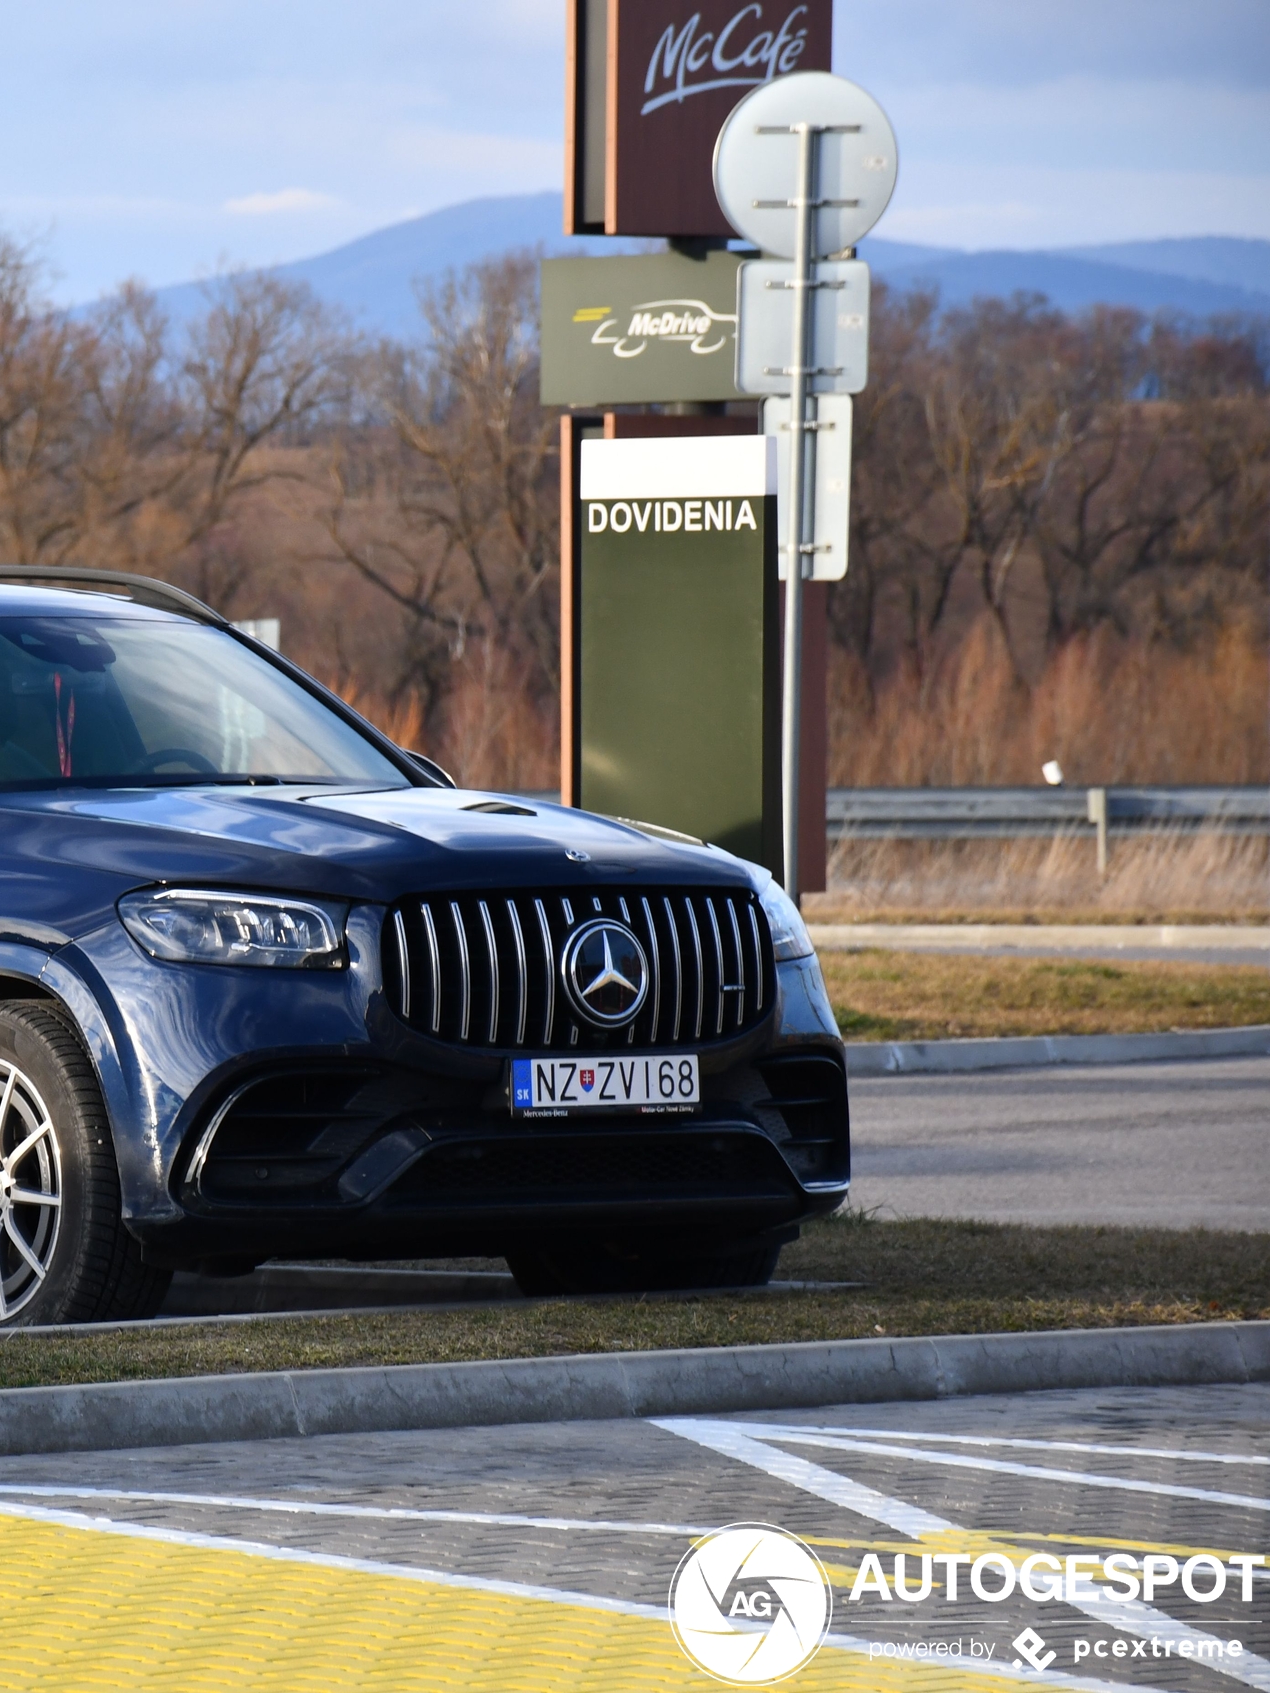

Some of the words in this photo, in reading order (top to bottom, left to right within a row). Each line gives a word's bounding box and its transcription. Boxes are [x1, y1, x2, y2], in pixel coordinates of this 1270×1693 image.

[644, 2, 809, 102] McCafé
[628, 312, 712, 336] McDrive
[588, 499, 758, 534] DOVIDENIA
[516, 1089, 529, 1100] SK
[536, 1063, 578, 1102] NZ
[523, 1109, 569, 1118] Mercedes-Benz
